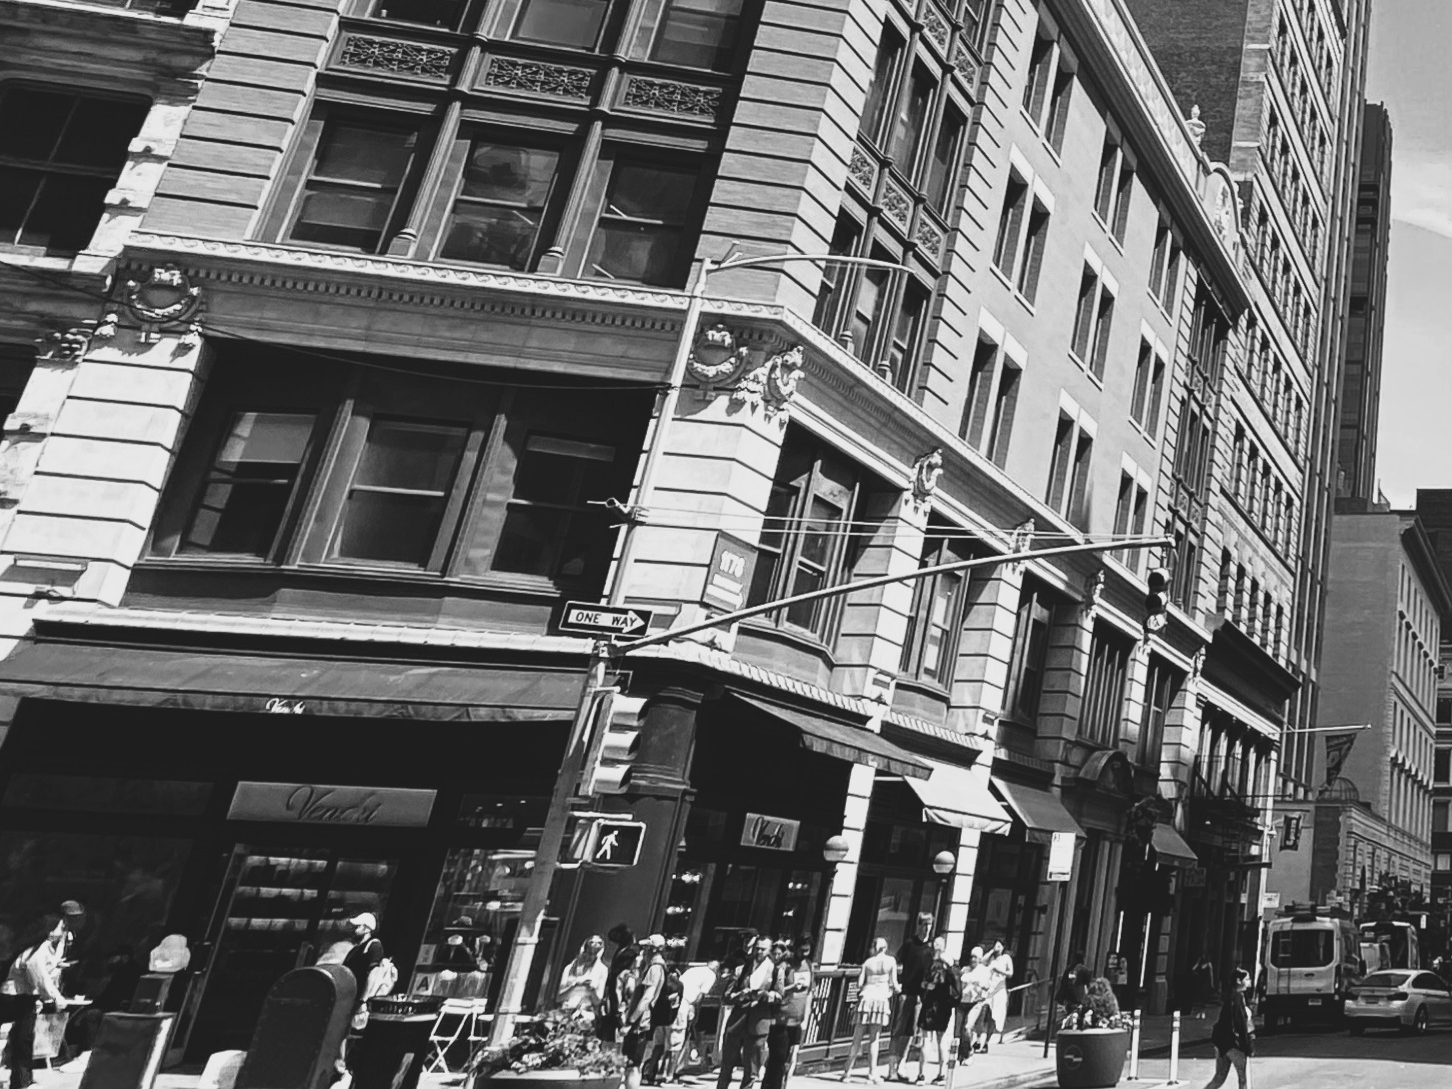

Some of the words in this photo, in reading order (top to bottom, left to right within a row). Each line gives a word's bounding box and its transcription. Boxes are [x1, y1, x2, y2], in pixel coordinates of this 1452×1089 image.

[575, 612, 601, 624] ONE
[612, 616, 637, 628] WAY
[416, 975, 429, 991] A
